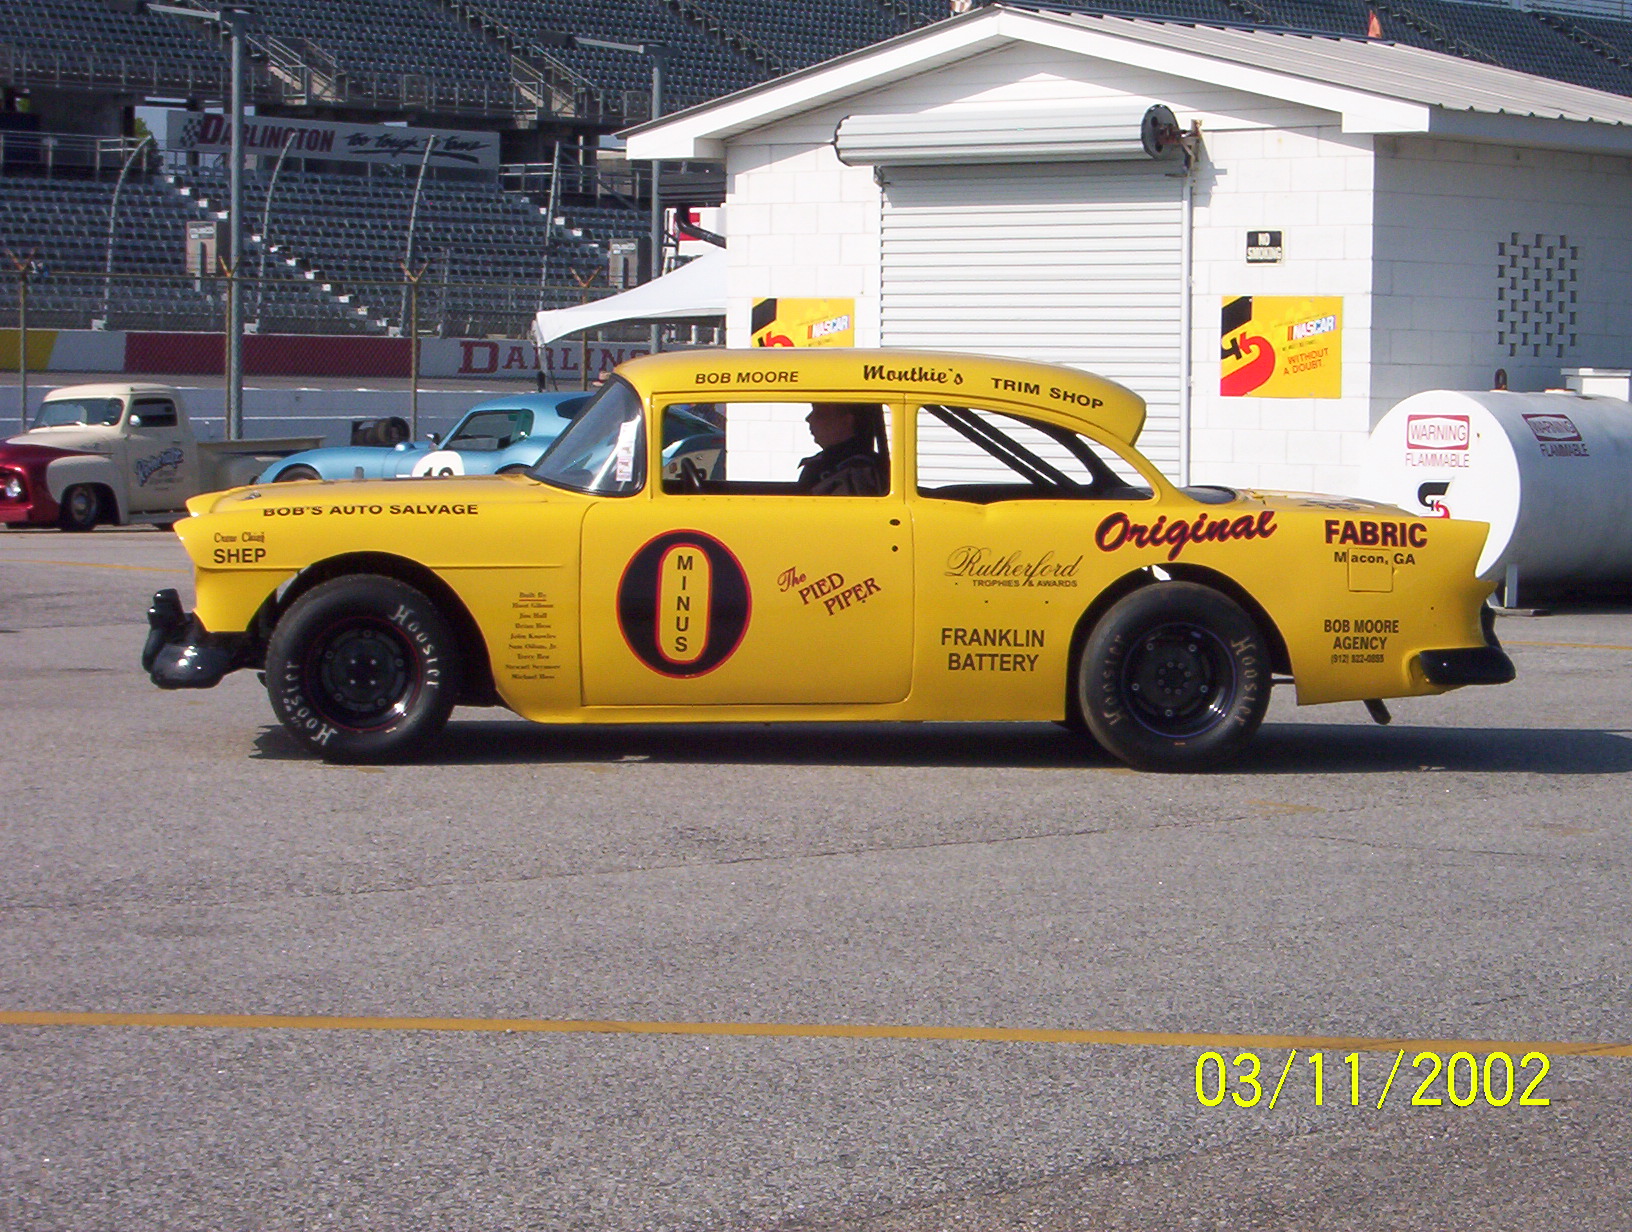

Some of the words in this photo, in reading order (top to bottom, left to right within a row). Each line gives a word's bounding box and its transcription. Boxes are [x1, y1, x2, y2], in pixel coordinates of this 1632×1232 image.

[198, 113, 335, 152] DARLINGTON
[1258, 232, 1271, 246] NO
[1247, 246, 1282, 260] SMOKING
[807, 314, 850, 340] NASCAR
[1287, 315, 1336, 341] NASCAR
[1287, 347, 1329, 365] WITHOUT
[695, 373, 731, 385] BOB
[736, 371, 799, 384] MOORE
[991, 377, 1040, 396] TRIM
[1049, 386, 1104, 410] SHOP
[1411, 424, 1467, 442] WARNING
[1531, 419, 1576, 435] WARNING
[1540, 443, 1590, 457] FLAMMABLE
[1405, 453, 1470, 468] FLAMMABLE
[263, 505, 323, 517] BOB'S
[329, 504, 383, 516] AUTO
[389, 504, 479, 516] SALVAGE
[1094, 510, 1278, 561] Original
[1324, 519, 1428, 549] FABRIC
[213, 547, 267, 564] SHEP
[1393, 553, 1416, 565] GA
[944, 545, 1084, 587] Rutherford
[776, 566, 807, 593] The
[798, 572, 845, 605] PIED
[973, 579, 1020, 587] TROPHIES
[1036, 580, 1078, 588] AWARDS
[674, 555, 694, 653] MINUS
[823, 577, 882, 617] PIPER
[1324, 619, 1350, 633] BOB
[1353, 619, 1399, 634] MOORE
[941, 627, 1045, 648] FRANKLIN
[1333, 636, 1388, 650] AGENCY
[948, 652, 1040, 672] BATTERY
